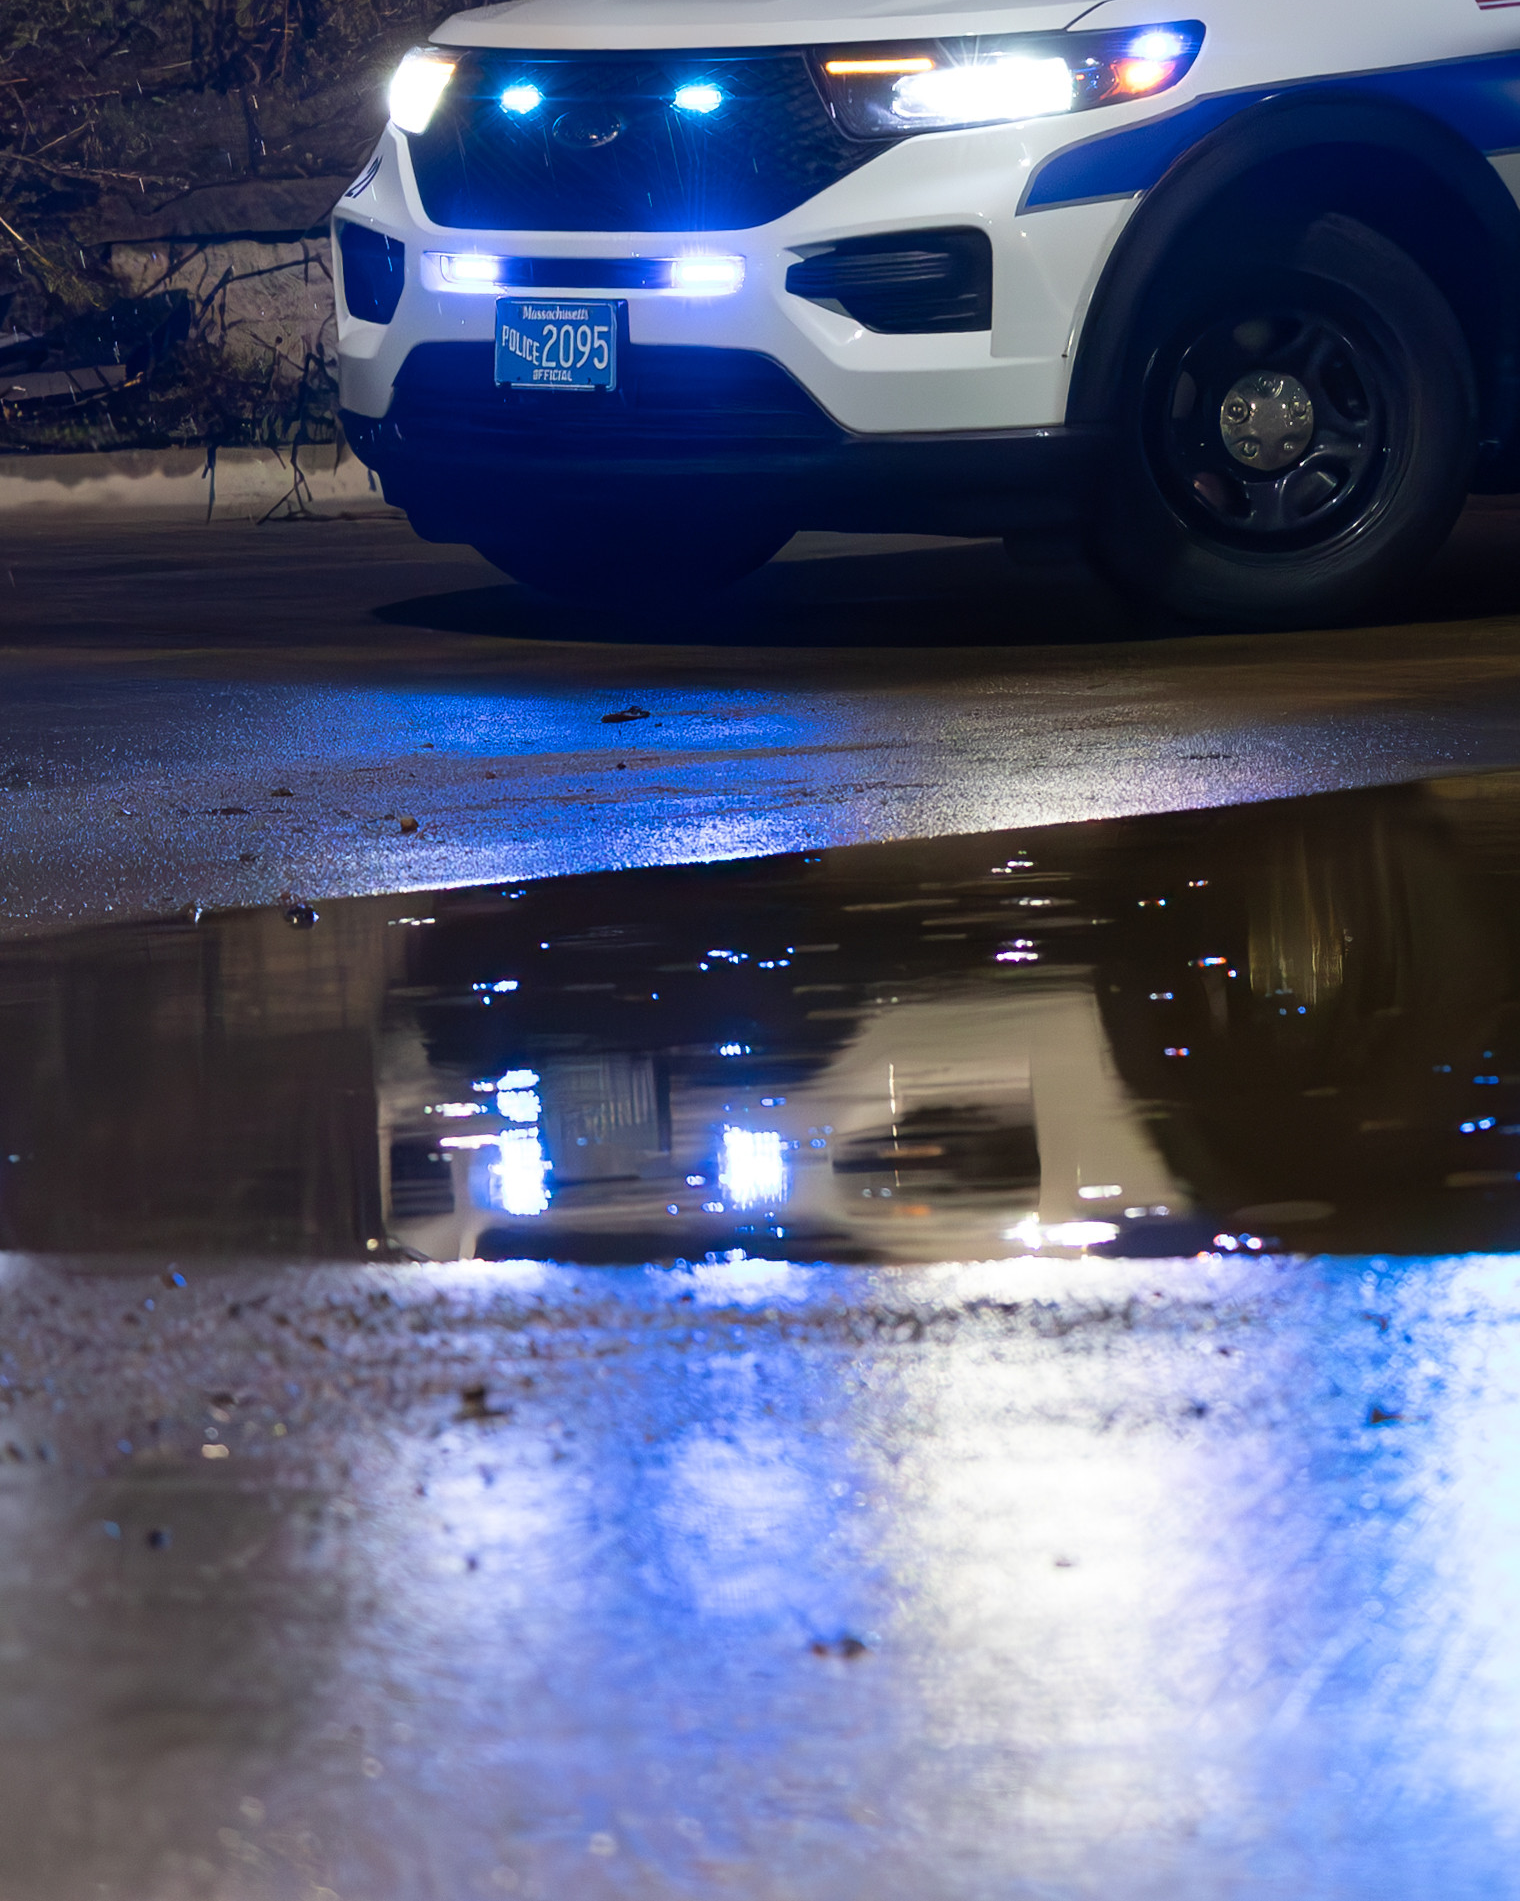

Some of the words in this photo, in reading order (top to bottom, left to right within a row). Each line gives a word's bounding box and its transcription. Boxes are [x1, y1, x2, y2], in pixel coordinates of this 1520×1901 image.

[344, 155, 384, 199] 21
[522, 305, 589, 320] Massachusetts
[502, 324, 540, 366] POLICE
[541, 323, 609, 370] 2095
[532, 368, 573, 382] OFFICIAL
